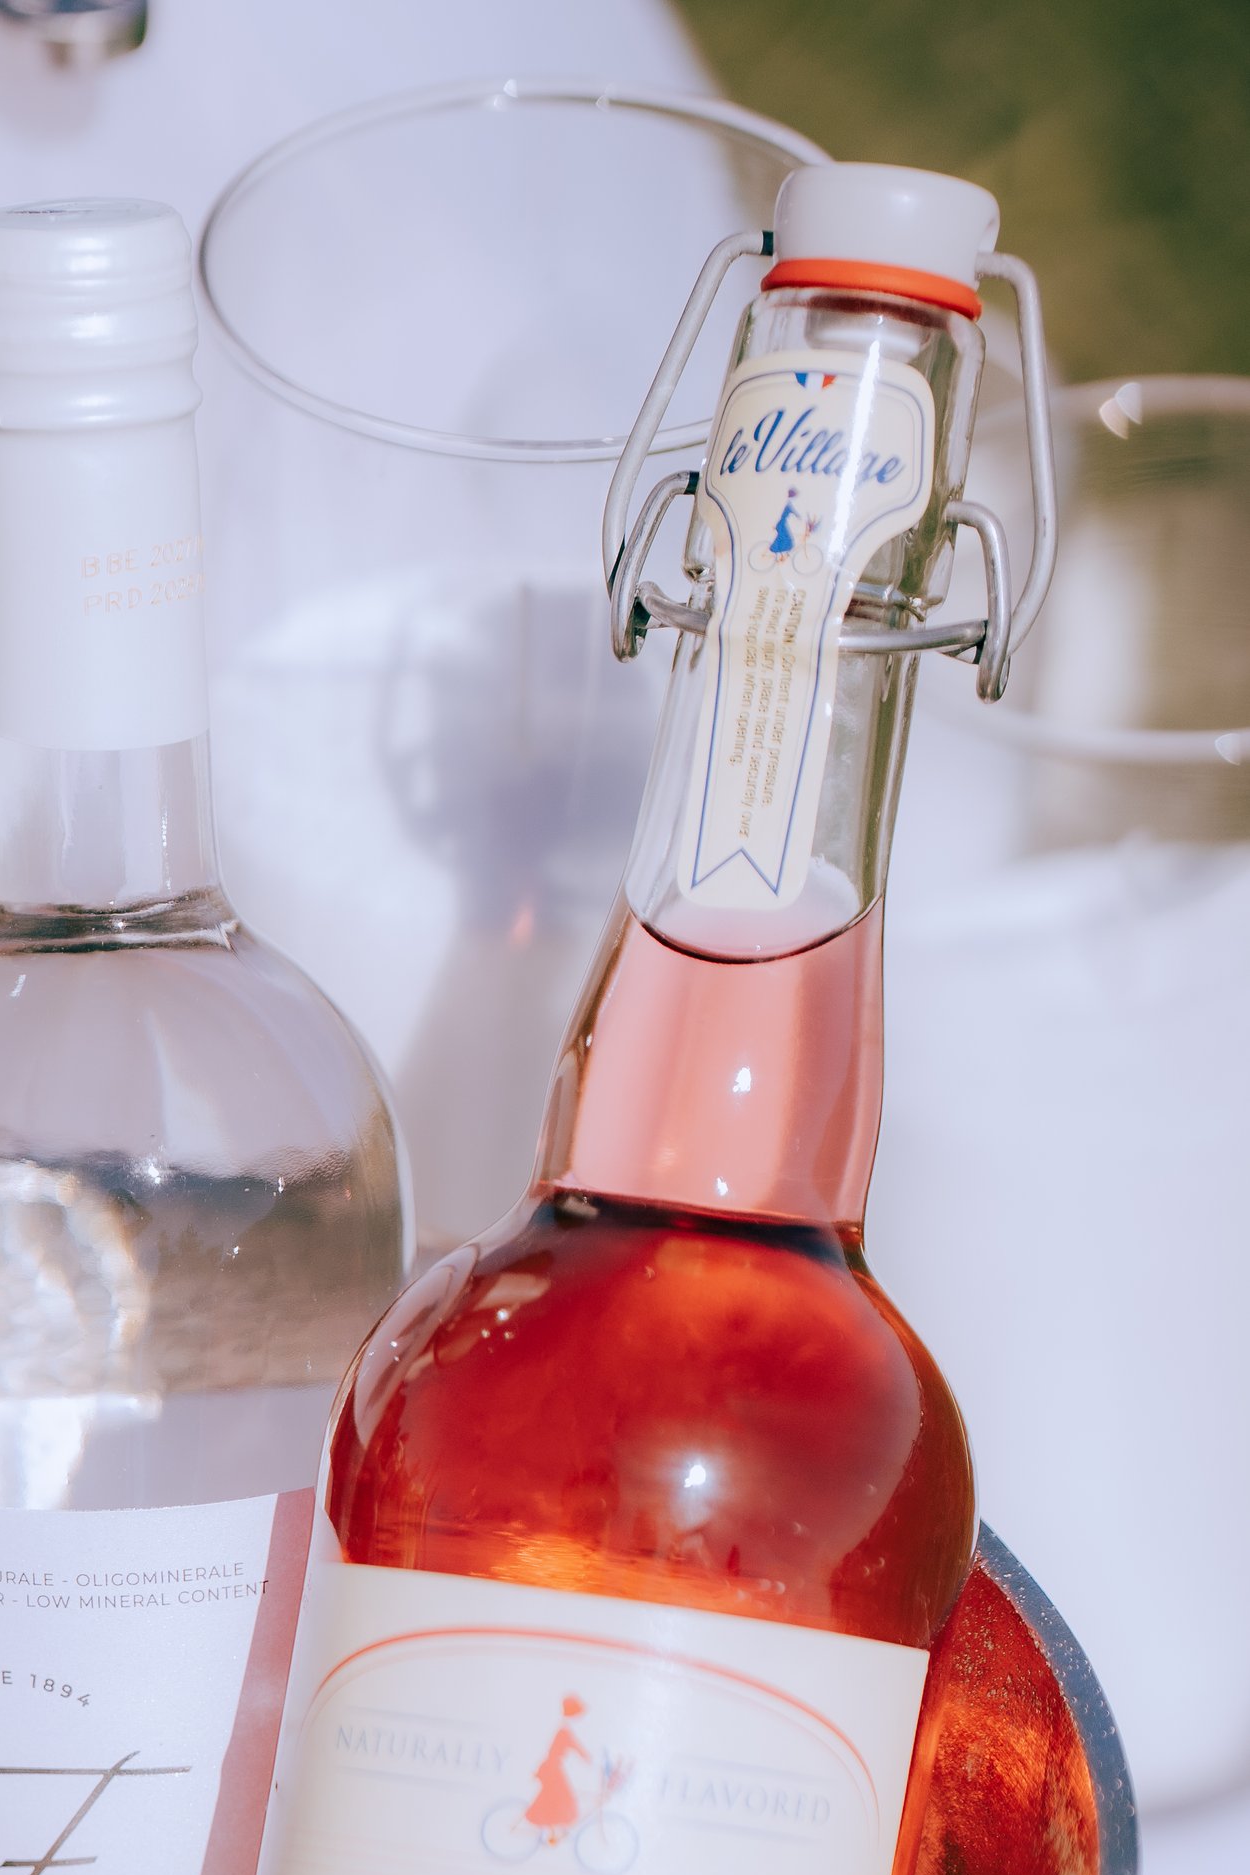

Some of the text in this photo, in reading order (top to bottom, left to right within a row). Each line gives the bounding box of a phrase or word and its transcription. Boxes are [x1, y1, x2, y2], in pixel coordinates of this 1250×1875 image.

[720, 424, 752, 478] le
[80, 548, 141, 579] BBE
[75, 1561, 245, 1588] OLIGOMINERALE
[26, 1593, 72, 1610] LOW
[78, 1591, 171, 1611] MINERAL
[177, 1579, 270, 1606] CONTENT
[28, 1673, 93, 1708] 1894
